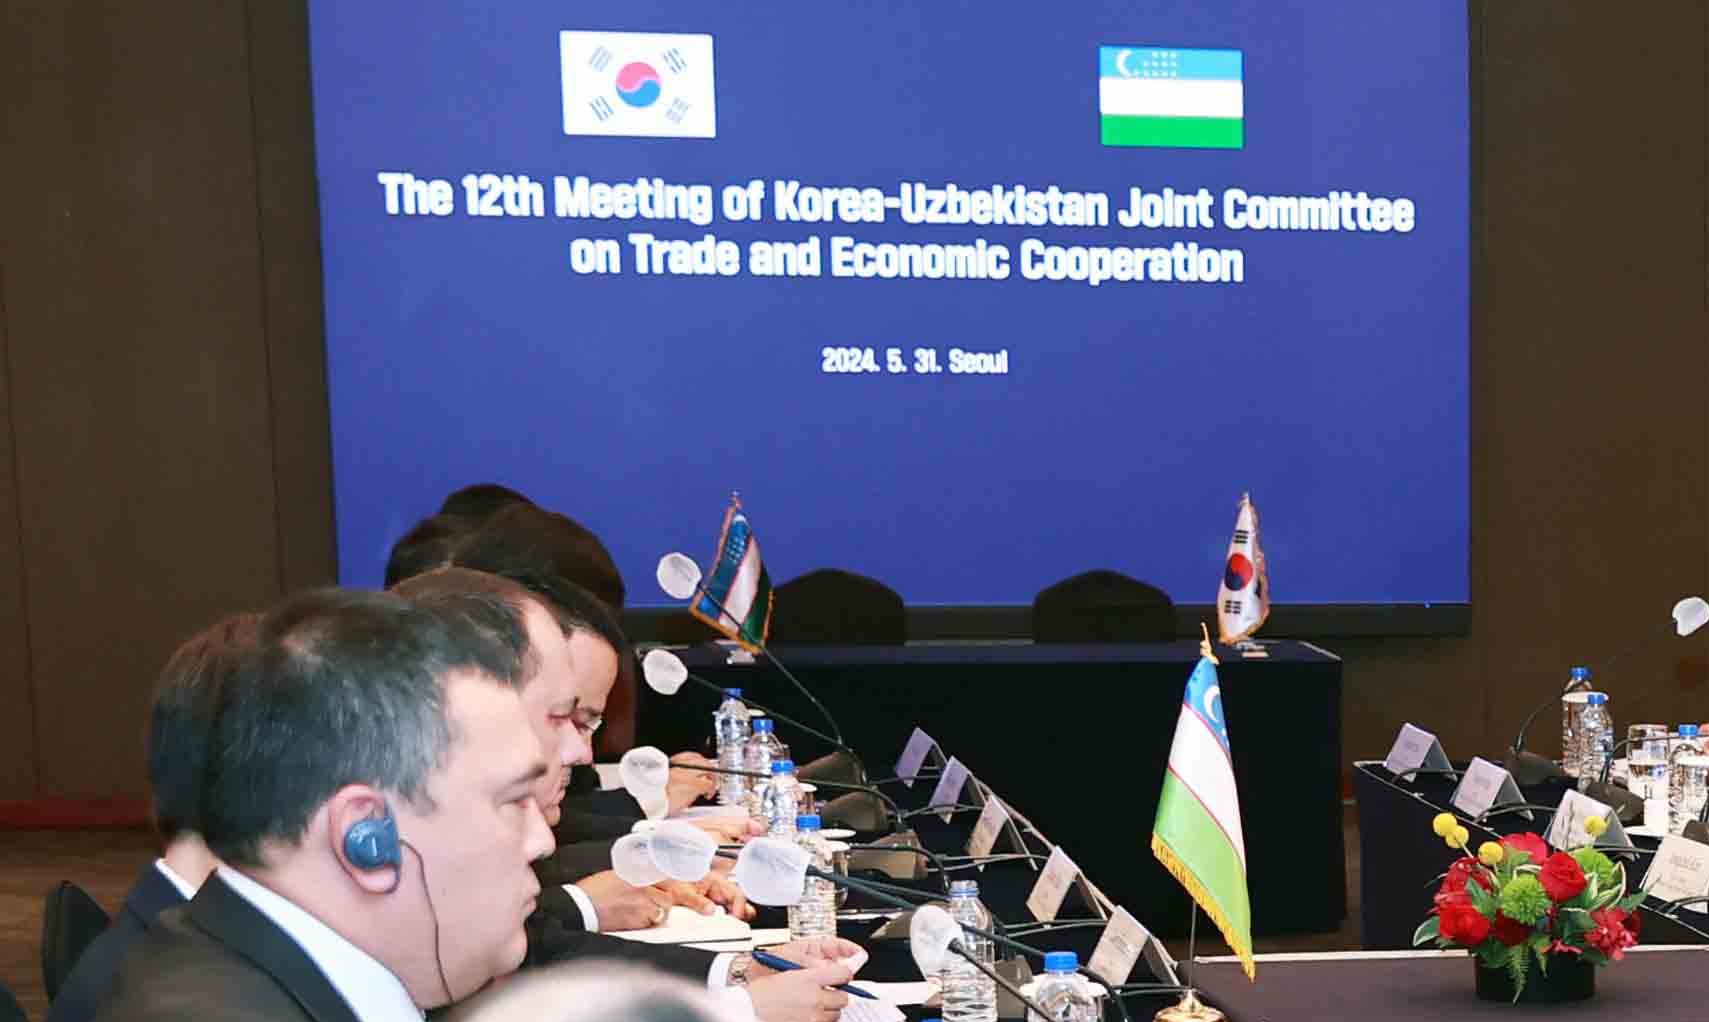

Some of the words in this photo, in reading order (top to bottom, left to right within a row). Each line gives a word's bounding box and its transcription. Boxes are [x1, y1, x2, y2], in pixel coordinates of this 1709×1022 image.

[377, 172, 454, 216] The
[461, 173, 545, 217] 12th
[554, 175, 713, 226] Meeting
[722, 179, 765, 221] of
[774, 180, 1109, 226] Korea-Uzbekistan
[1117, 187, 1214, 228] Joint
[1223, 188, 1415, 233] Committee
[570, 237, 621, 274] on
[628, 232, 741, 276] Trade
[749, 236, 821, 277] and
[831, 236, 1010, 280] Economic
[1020, 238, 1244, 286] Cooperation
[822, 347, 881, 373] 2024.
[886, 348, 908, 373] 5.
[914, 348, 943, 373] 31.
[948, 348, 1009, 374] Seoul
